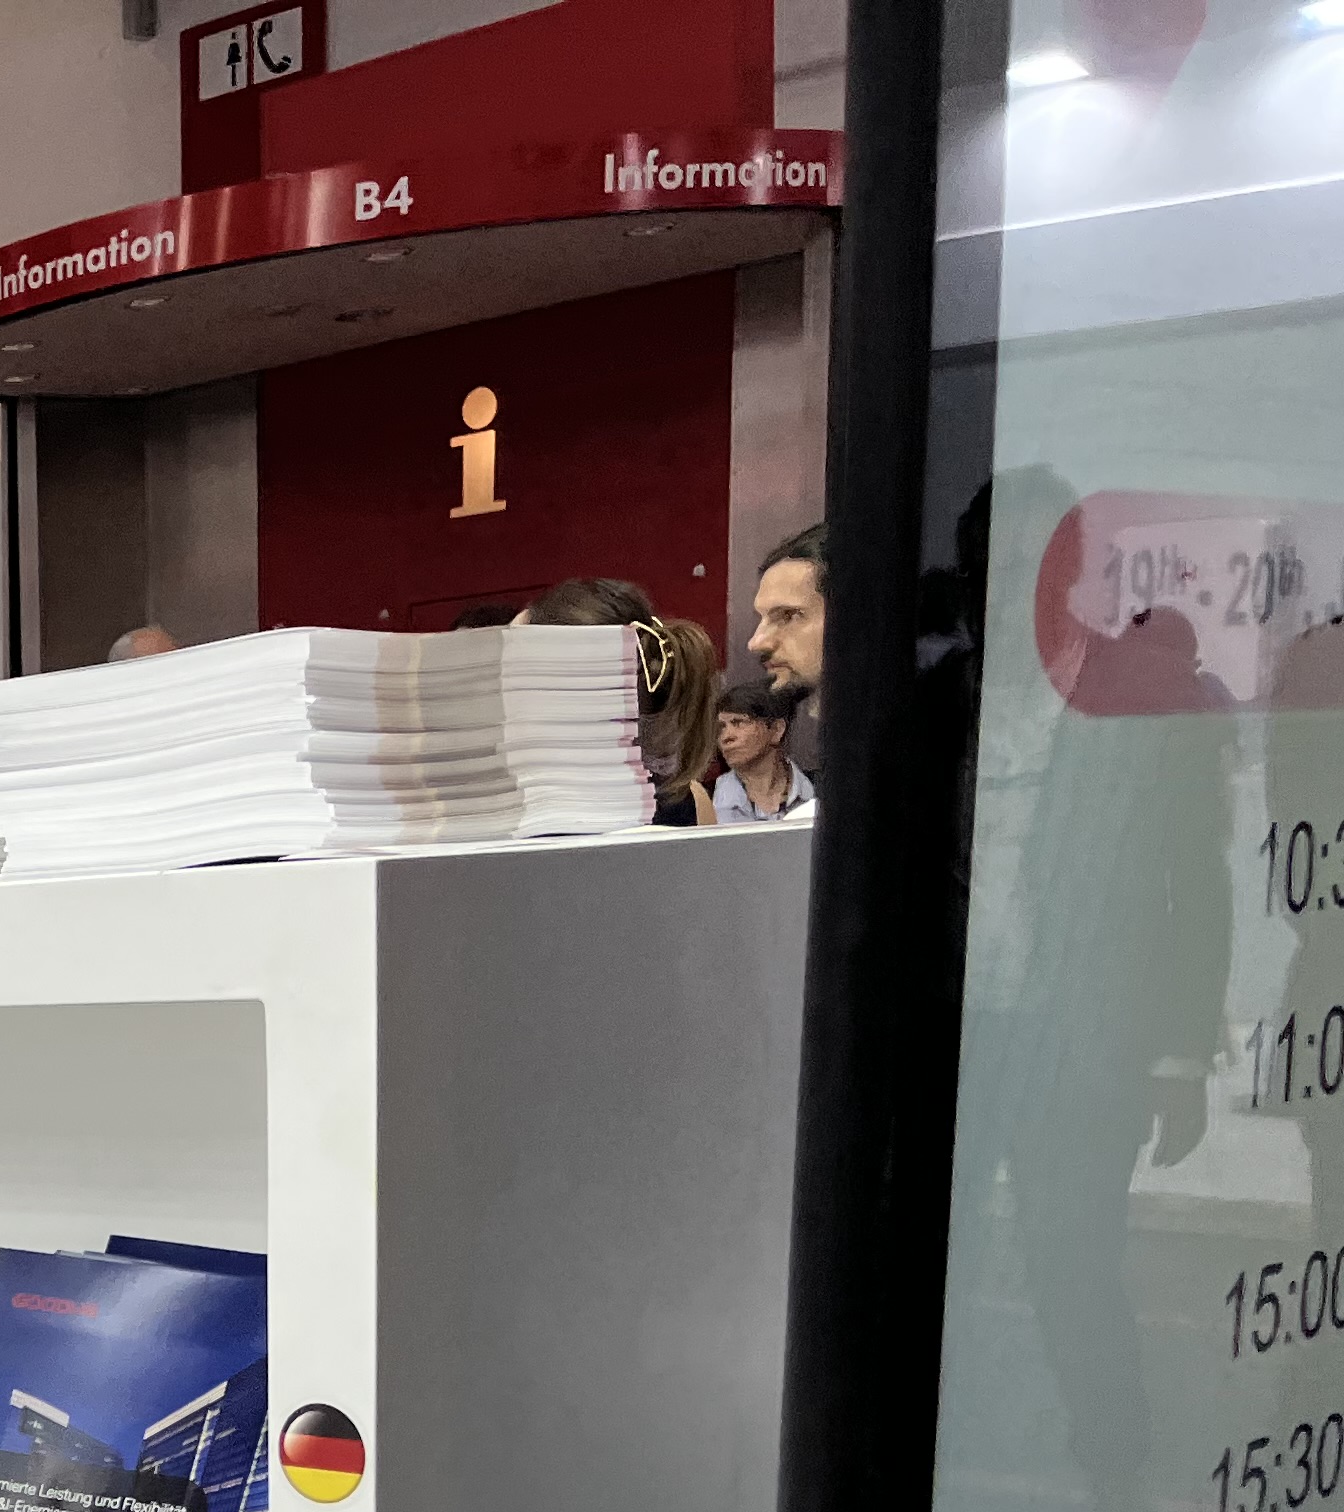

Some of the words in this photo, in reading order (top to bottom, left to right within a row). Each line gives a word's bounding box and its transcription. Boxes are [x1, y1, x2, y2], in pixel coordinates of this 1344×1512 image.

[604, 149, 830, 192] Information
[354, 176, 414, 220] B4
[39, 1483, 93, 1509] Leistung
[95, 1494, 121, 1510] und
